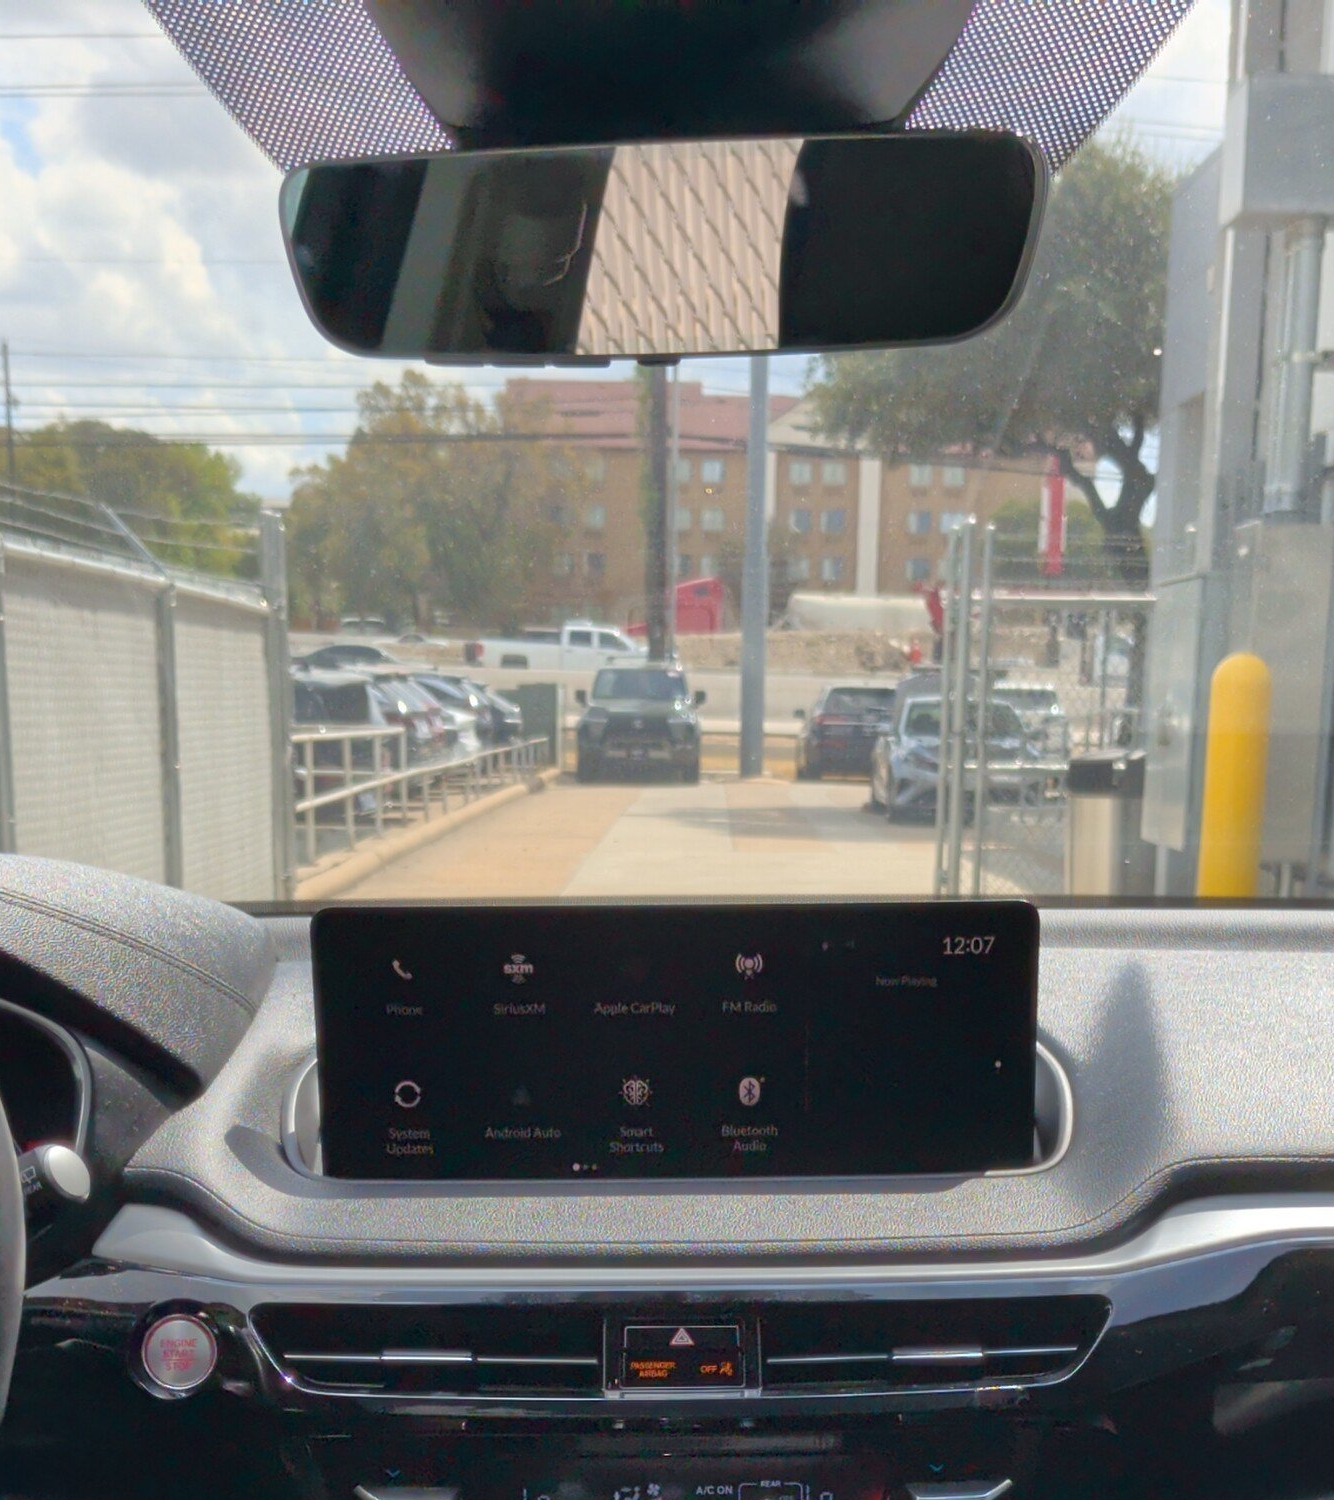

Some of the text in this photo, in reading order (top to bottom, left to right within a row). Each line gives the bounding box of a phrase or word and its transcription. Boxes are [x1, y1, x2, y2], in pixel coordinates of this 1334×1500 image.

[941, 935, 996, 955] 12:07
[503, 963, 534, 974] sxm
[385, 1002, 423, 1016] Phone
[493, 1002, 546, 1015] SiriusXM
[594, 1001, 676, 1017] Apple CarPlay
[722, 1000, 778, 1013] FM Radio
[389, 1127, 431, 1141] System
[484, 1126, 562, 1139] Android Auto
[619, 1126, 655, 1138] Smart
[721, 1124, 778, 1137] Bluetooth
[386, 1143, 434, 1156] Updates
[609, 1140, 665, 1154] Shortcuts
[732, 1140, 767, 1152] Audio
[160, 1338, 197, 1348] ENGINE
[163, 1349, 194, 1358] START
[165, 1361, 194, 1372] STOP
[630, 1361, 676, 1370] PASSENGER
[700, 1364, 718, 1374] OFF
[639, 1369, 668, 1378] AIRBAG
[695, 1484, 734, 1496] A/C ON
[760, 1480, 782, 1488] REAR
